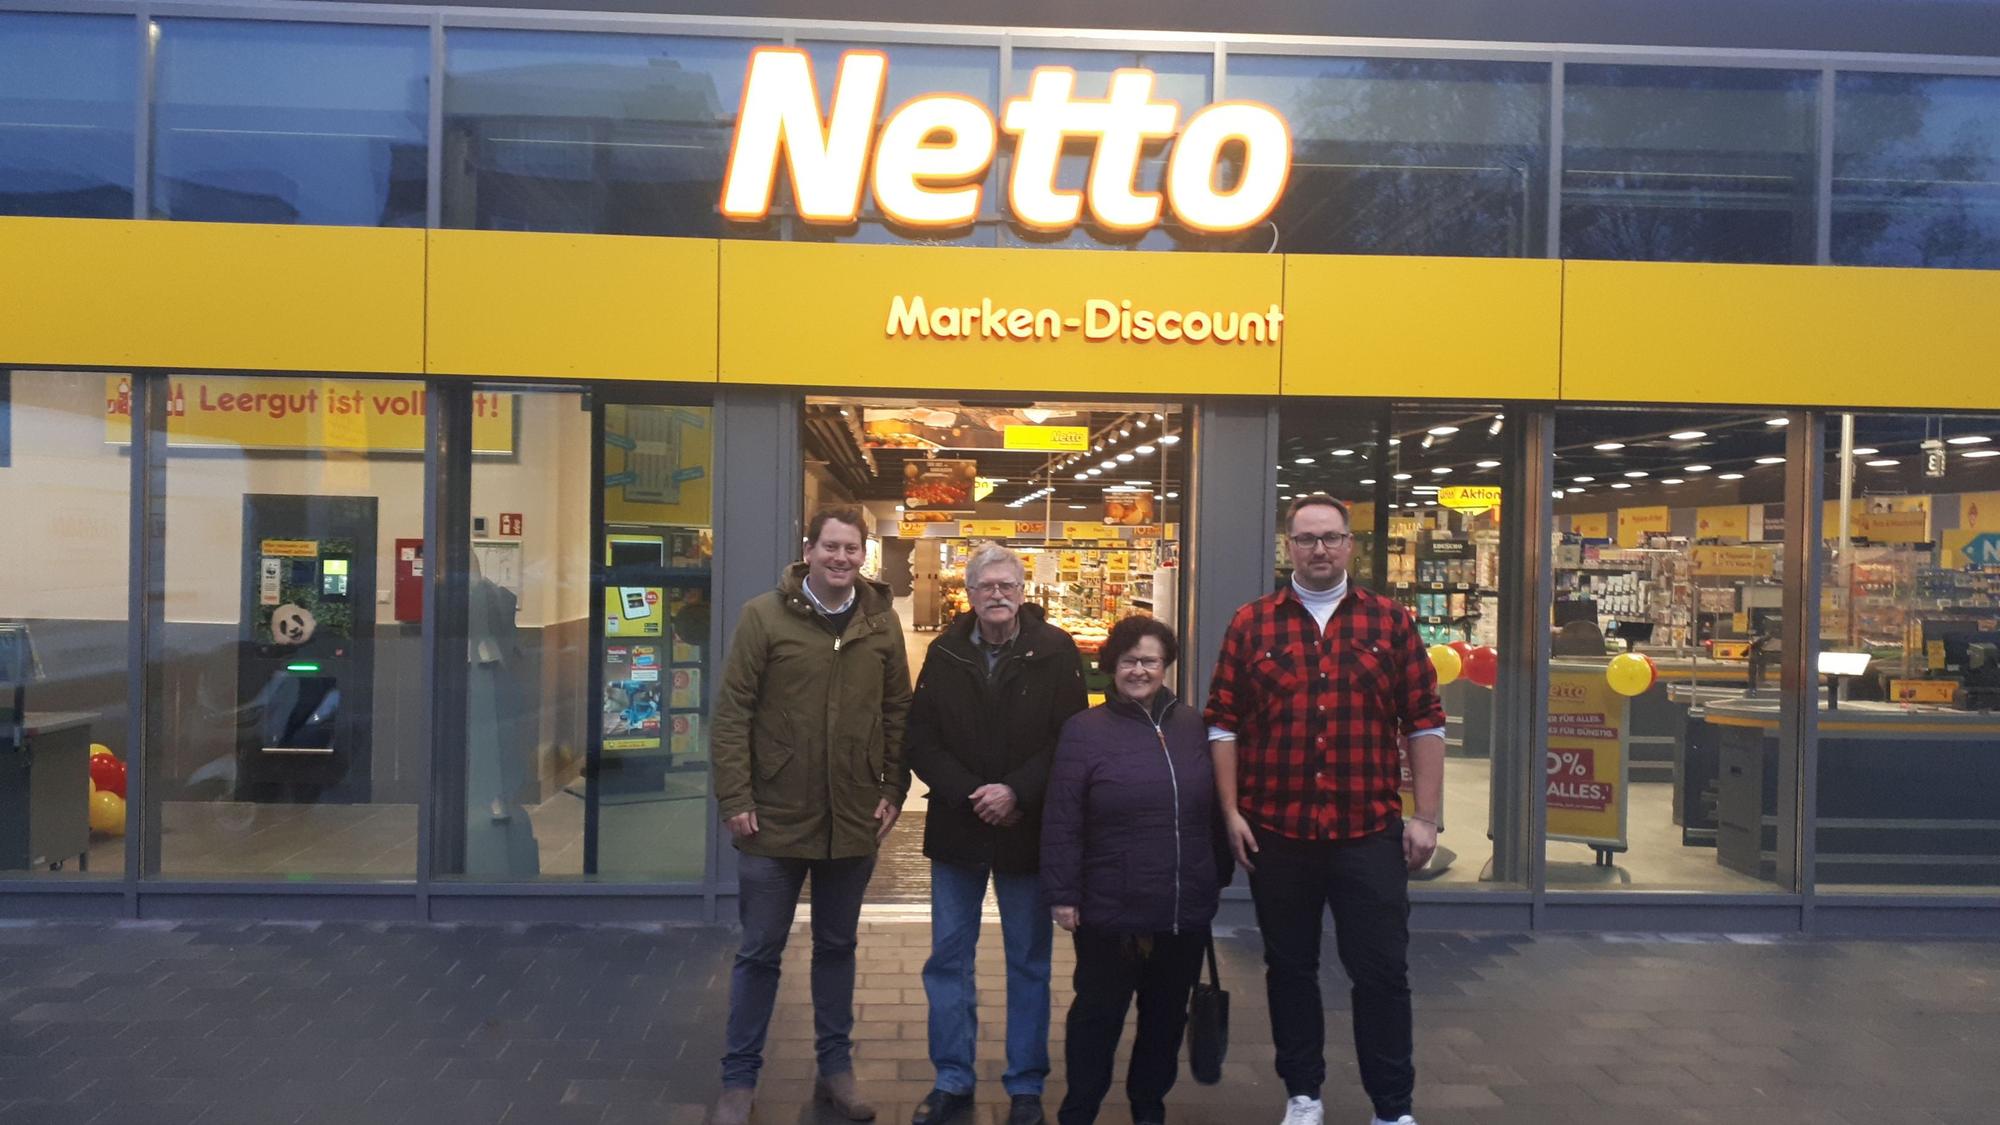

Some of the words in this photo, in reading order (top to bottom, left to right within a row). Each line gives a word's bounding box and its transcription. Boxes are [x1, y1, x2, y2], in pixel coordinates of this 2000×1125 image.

[719, 45, 1294, 234] Netto
[885, 295, 1284, 343] Marken-Discount
[200, 385, 318, 418] Leergut
[328, 388, 363, 414] ist
[1460, 488, 1500, 499] Aktion
[1548, 684, 1586, 698] etto
